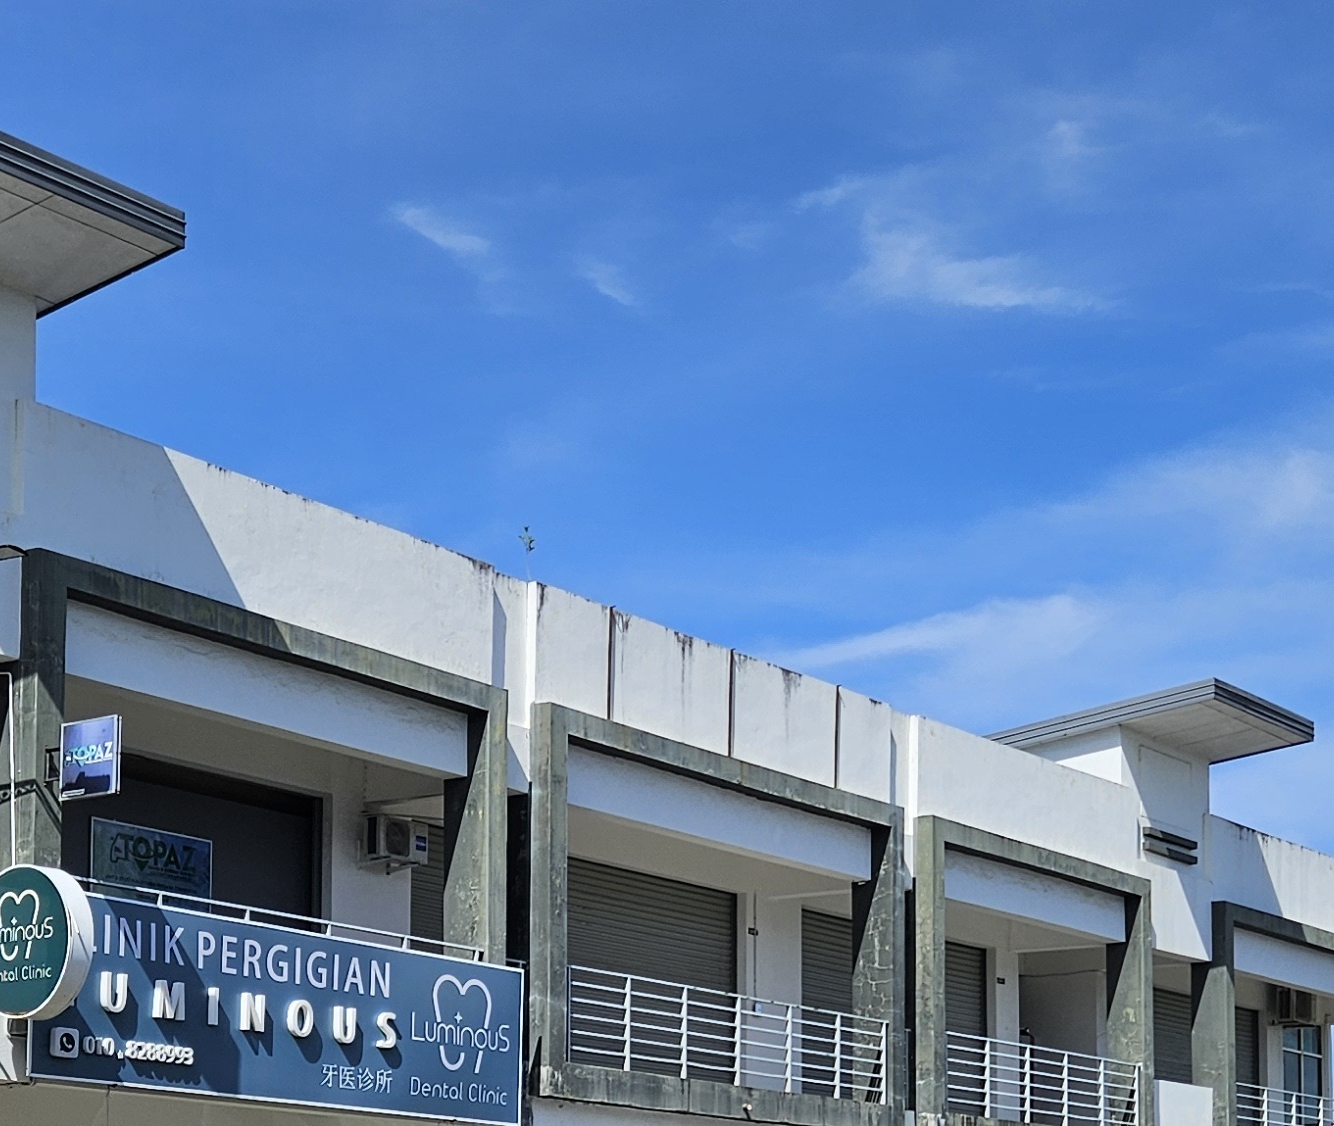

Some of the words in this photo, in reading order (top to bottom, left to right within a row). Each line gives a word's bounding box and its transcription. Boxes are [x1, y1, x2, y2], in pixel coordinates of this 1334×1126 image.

[116, 833, 196, 872] TOPAZ
[21, 964, 52, 981] Clinic
[92, 914, 185, 966] INIK
[197, 931, 391, 998] PERGIGIAN
[99, 971, 398, 1049] UMINOUS
[320, 1063, 393, 1095] 牙医诊所
[410, 1076, 463, 1101] Dental
[468, 1083, 508, 1106] Clinic
